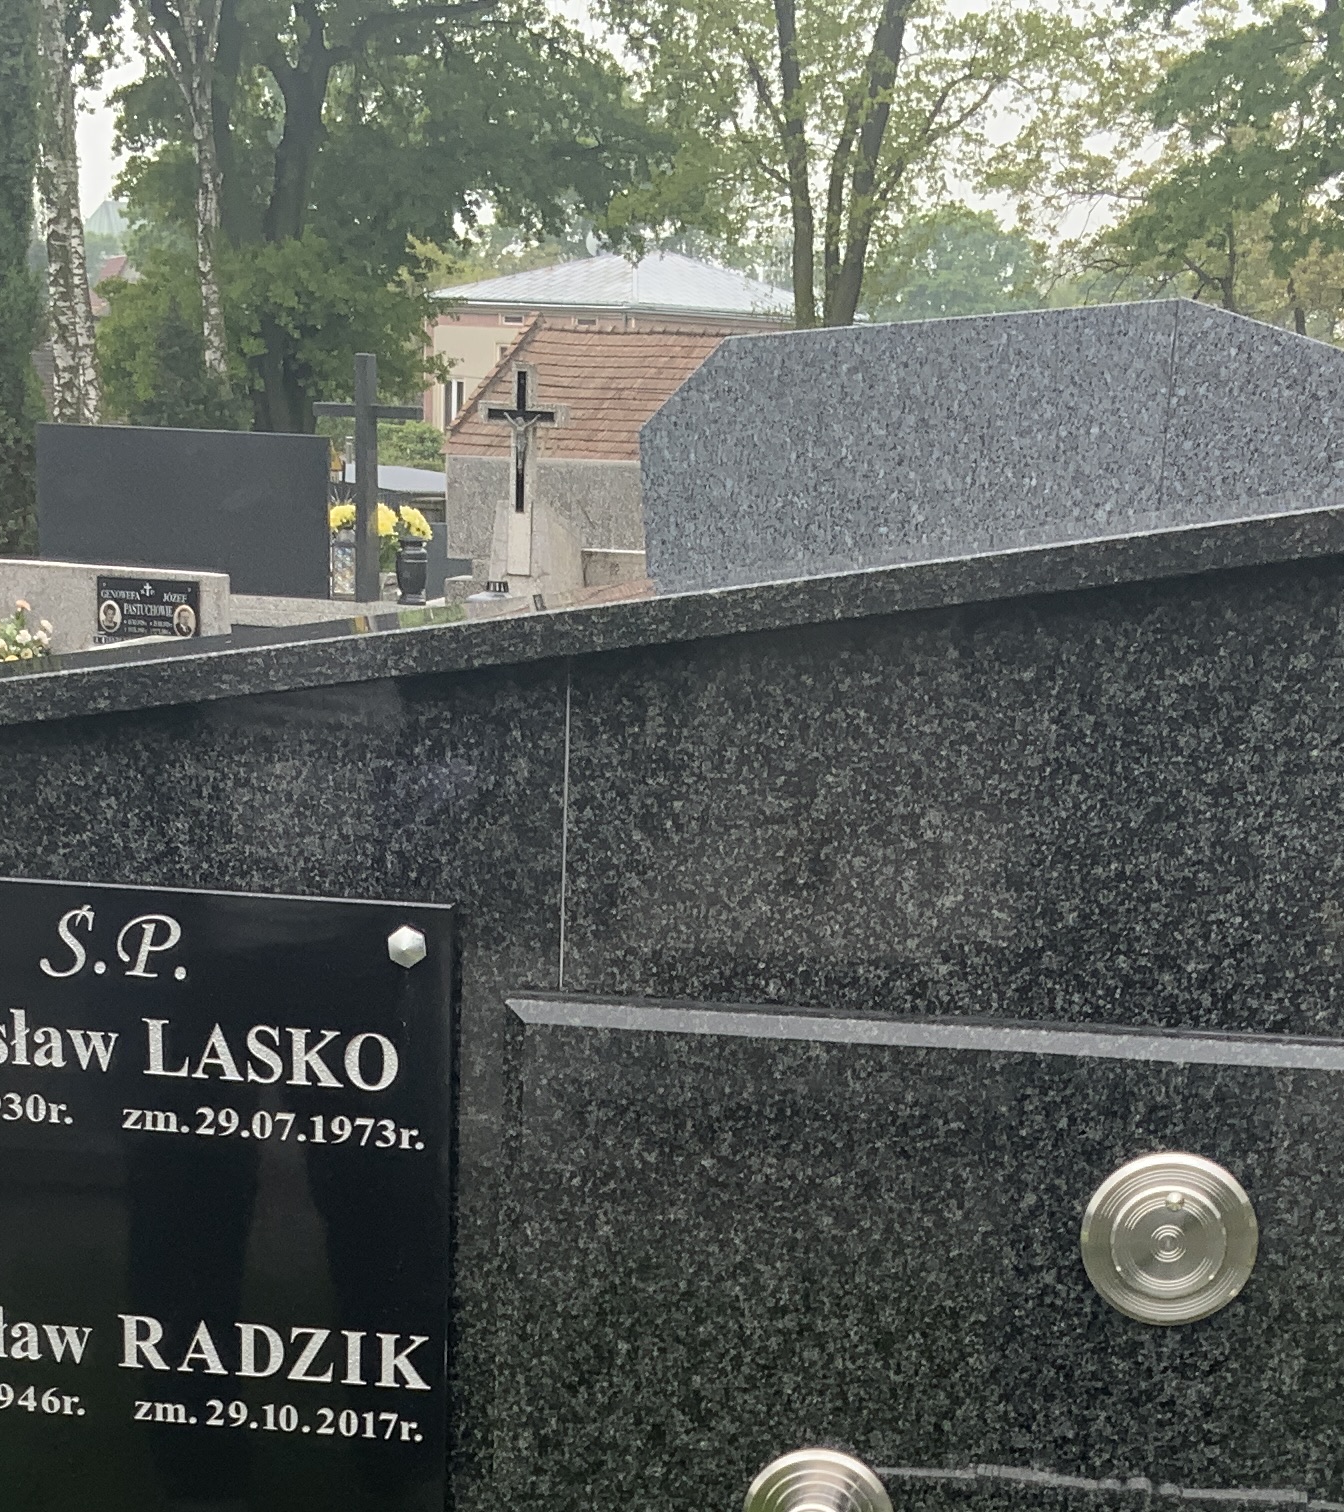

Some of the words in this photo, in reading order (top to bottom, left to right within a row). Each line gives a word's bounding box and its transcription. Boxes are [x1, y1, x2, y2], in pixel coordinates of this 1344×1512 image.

[100, 589, 141, 601] GENOWEFA
[141, 1017, 399, 1092] LASKO
[117, 1314, 432, 1390] RADZIK
